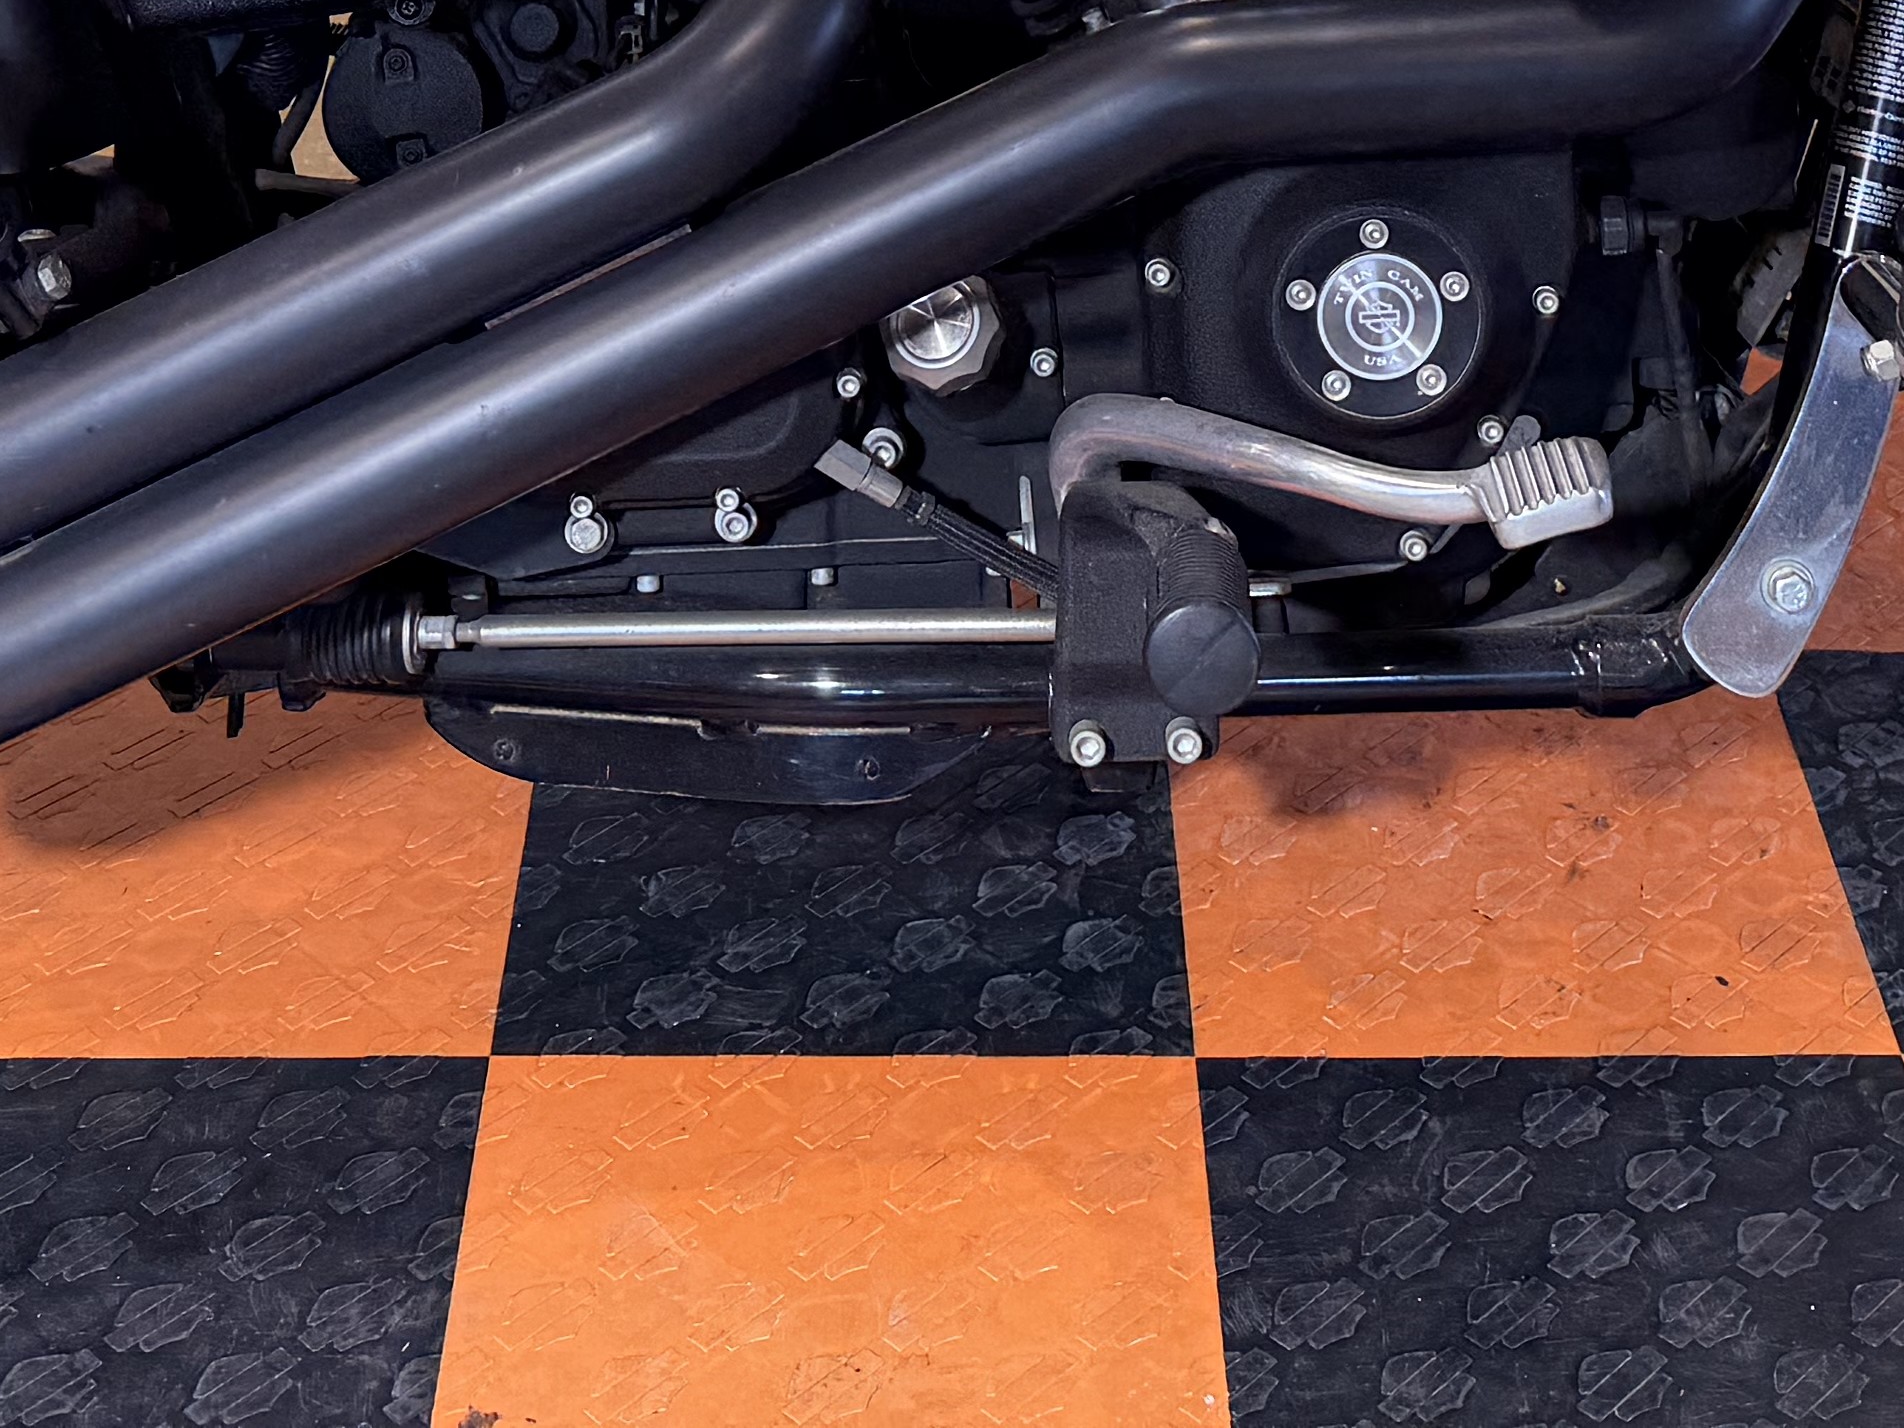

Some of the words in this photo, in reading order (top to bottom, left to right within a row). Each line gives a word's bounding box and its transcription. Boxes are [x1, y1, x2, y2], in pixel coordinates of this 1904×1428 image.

[1333, 269, 1374, 305] TWIN
[1387, 269, 1425, 302] CAM
[1363, 353, 1400, 367] USA
